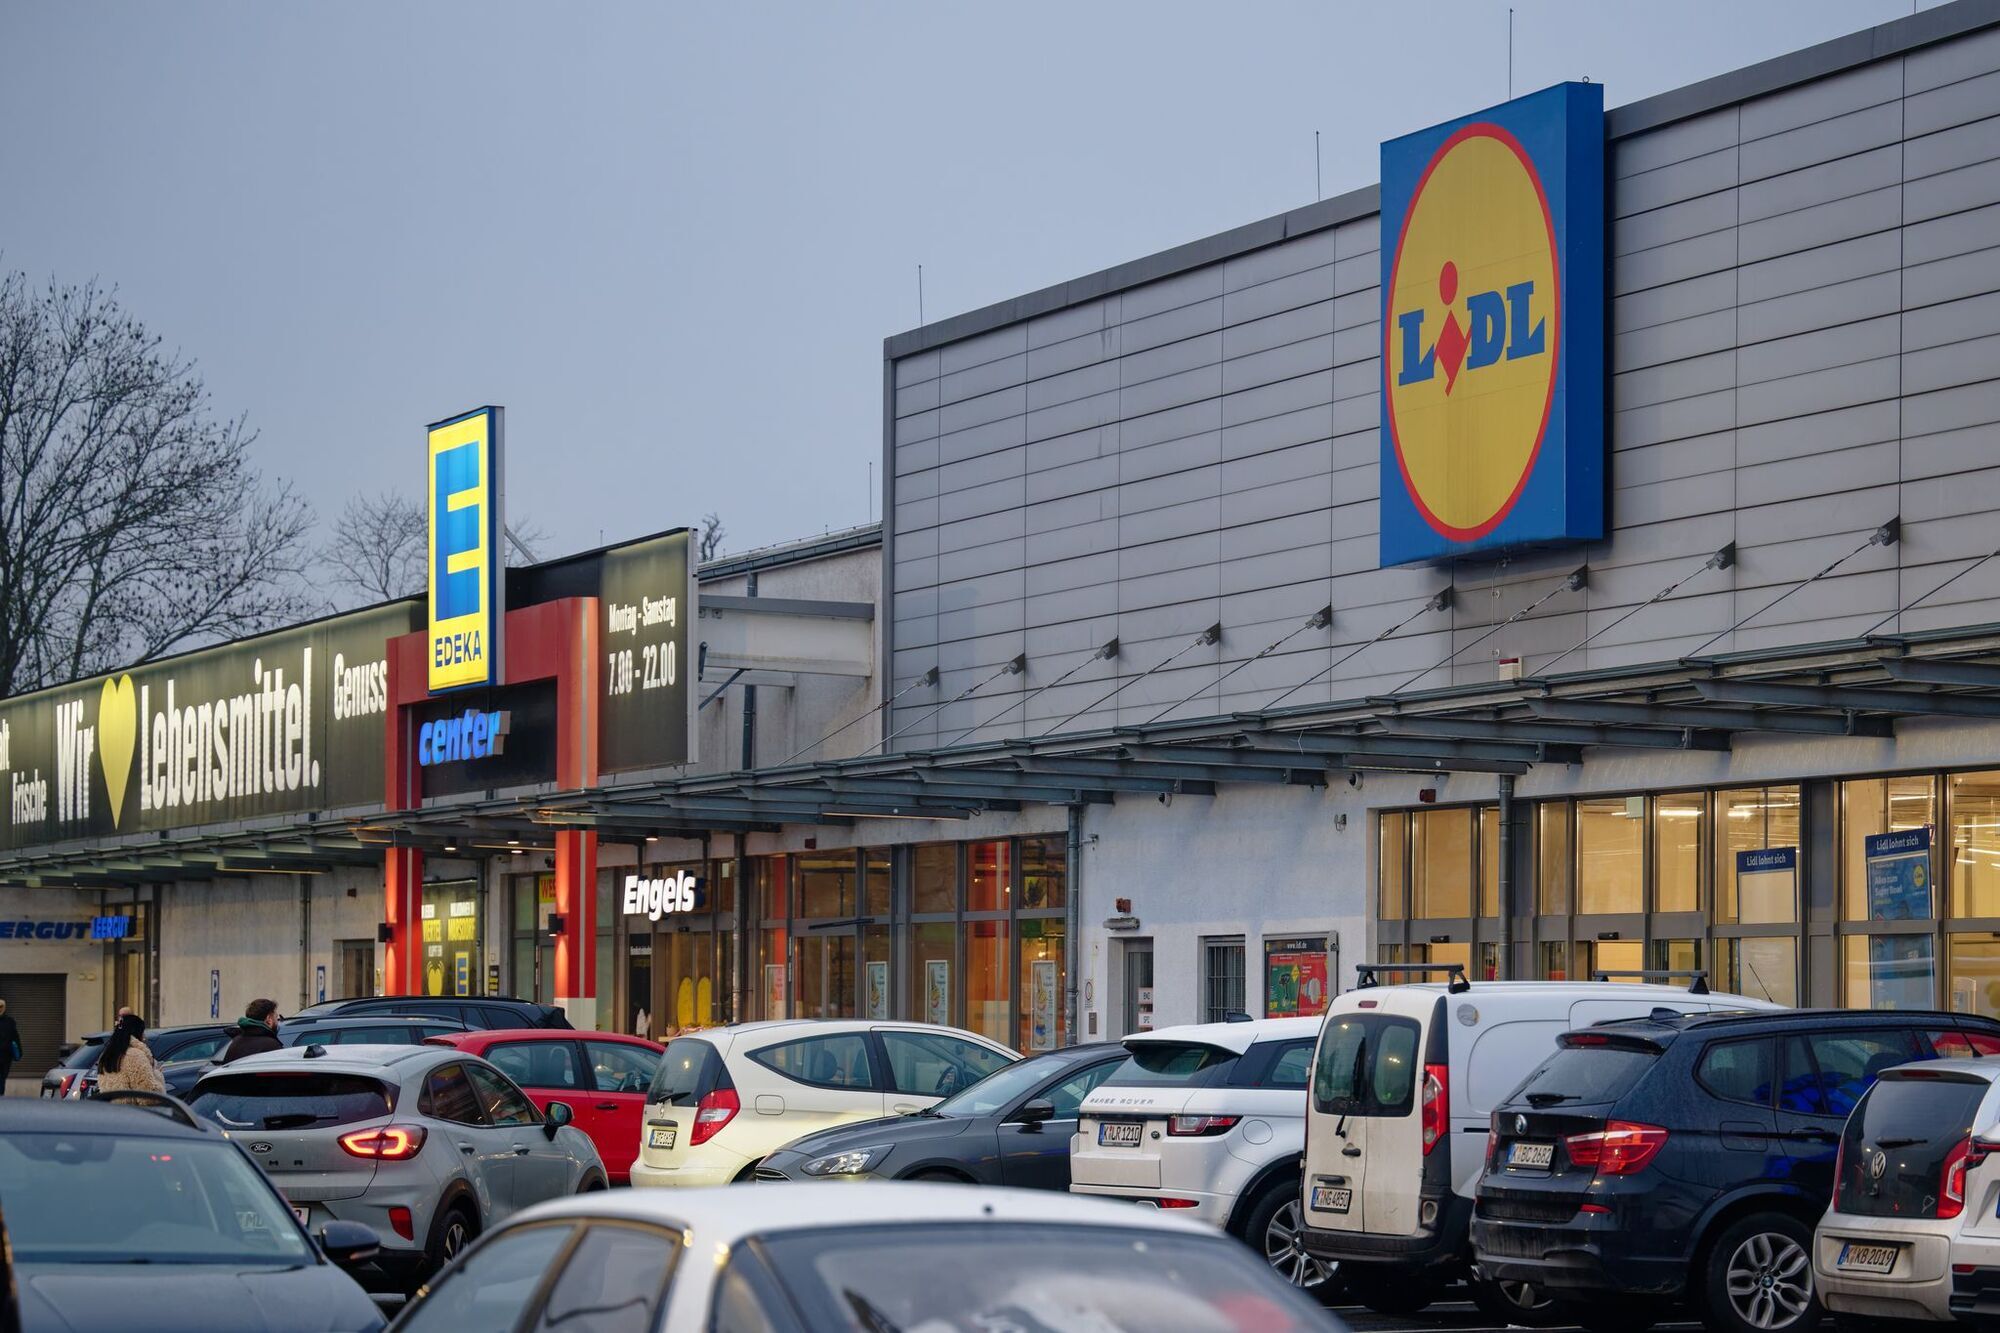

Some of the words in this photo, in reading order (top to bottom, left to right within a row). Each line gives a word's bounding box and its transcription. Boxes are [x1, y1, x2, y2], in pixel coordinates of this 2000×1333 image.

[609, 604, 637, 636] Montag
[643, 595, 676, 628] Samstag
[435, 630, 482, 668] EDEKA
[609, 649, 633, 695] 7.00
[643, 640, 676, 689] 22.00
[334, 653, 387, 720] Genuss
[140, 647, 320, 811] Lebensmittel.
[419, 709, 501, 767] center
[57, 699, 94, 822] Wir
[12, 769, 47, 824] Frische
[1746, 855, 1758, 866] Lidl
[1759, 854, 1774, 865] lohnt
[1774, 853, 1786, 864] sich
[1876, 839, 1889, 851] Lidl
[1889, 836, 1906, 849] lohnt
[1906, 834, 1919, 847] sich
[623, 870, 696, 921] Engels
